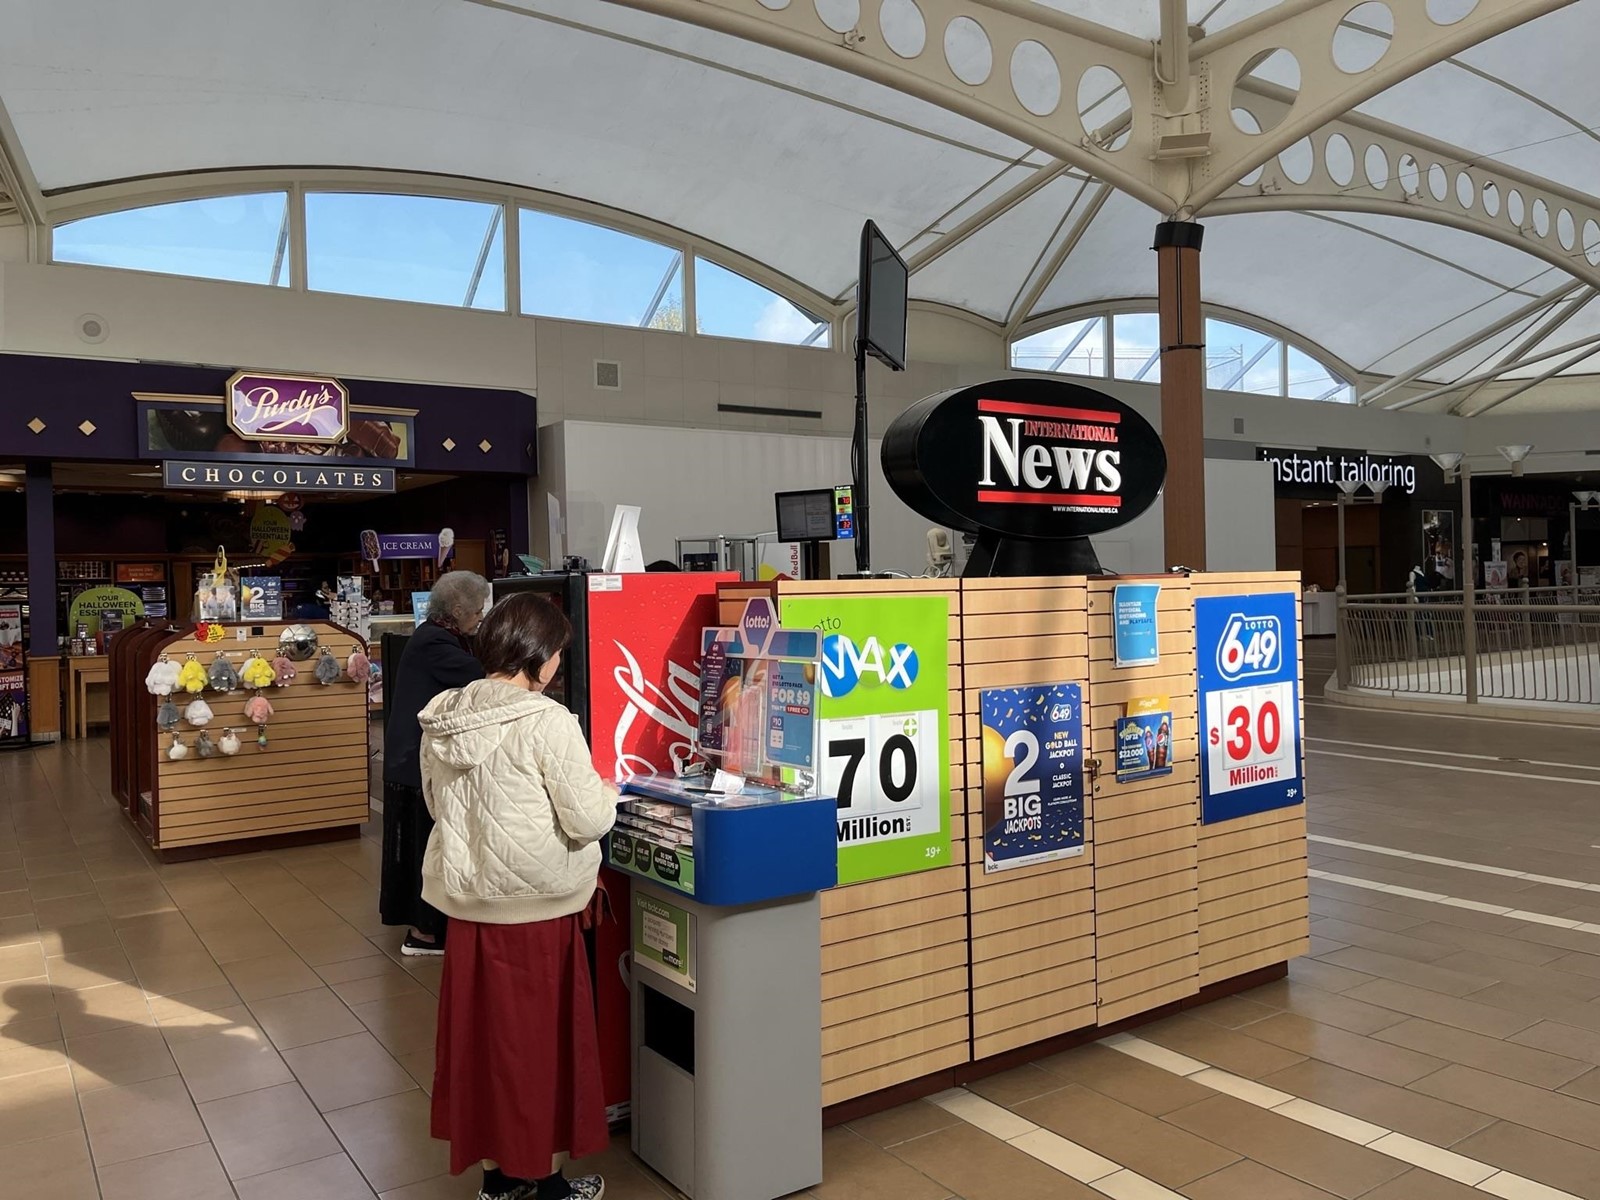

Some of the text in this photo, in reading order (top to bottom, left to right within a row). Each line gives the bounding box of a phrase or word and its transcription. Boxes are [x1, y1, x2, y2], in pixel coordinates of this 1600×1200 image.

[241, 385, 337, 431] Purdy's
[1023, 419, 1118, 443] INTERNATIONAL
[978, 416, 1122, 492] News
[181, 467, 382, 487] CHOCOLATES
[1340, 456, 1415, 494] tailoring
[1052, 505, 1118, 514] WWW.INTERNATIONALNEWS.CA
[382, 541, 432, 550] ICE CREAM
[790, 544, 799, 575] Red Bull
[79, 601, 136, 609] HALLOWEEN
[249, 586, 264, 604] 2
[745, 615, 770, 629] lotto!
[812, 616, 841, 630] otto
[1245, 620, 1274, 630] LOTTO
[1222, 621, 1277, 674] 649
[822, 634, 913, 697] MAX
[771, 688, 811, 706] FOR $9
[1054, 731, 1069, 740] NEW
[1210, 701, 1281, 761] $ 30
[1045, 739, 1078, 749] GOLD BALL
[1049, 749, 1075, 759] JACKPOT
[828, 733, 918, 809] 70
[1003, 730, 1041, 797] 2
[1052, 773, 1071, 781] CLASSIC
[1052, 780, 1072, 789] JACKPOT
[1229, 766, 1274, 787] Million
[1004, 794, 1042, 820] BIG
[836, 815, 904, 843] Million
[1004, 815, 1042, 835] JACKPOTS
[925, 846, 941, 858] 19+
